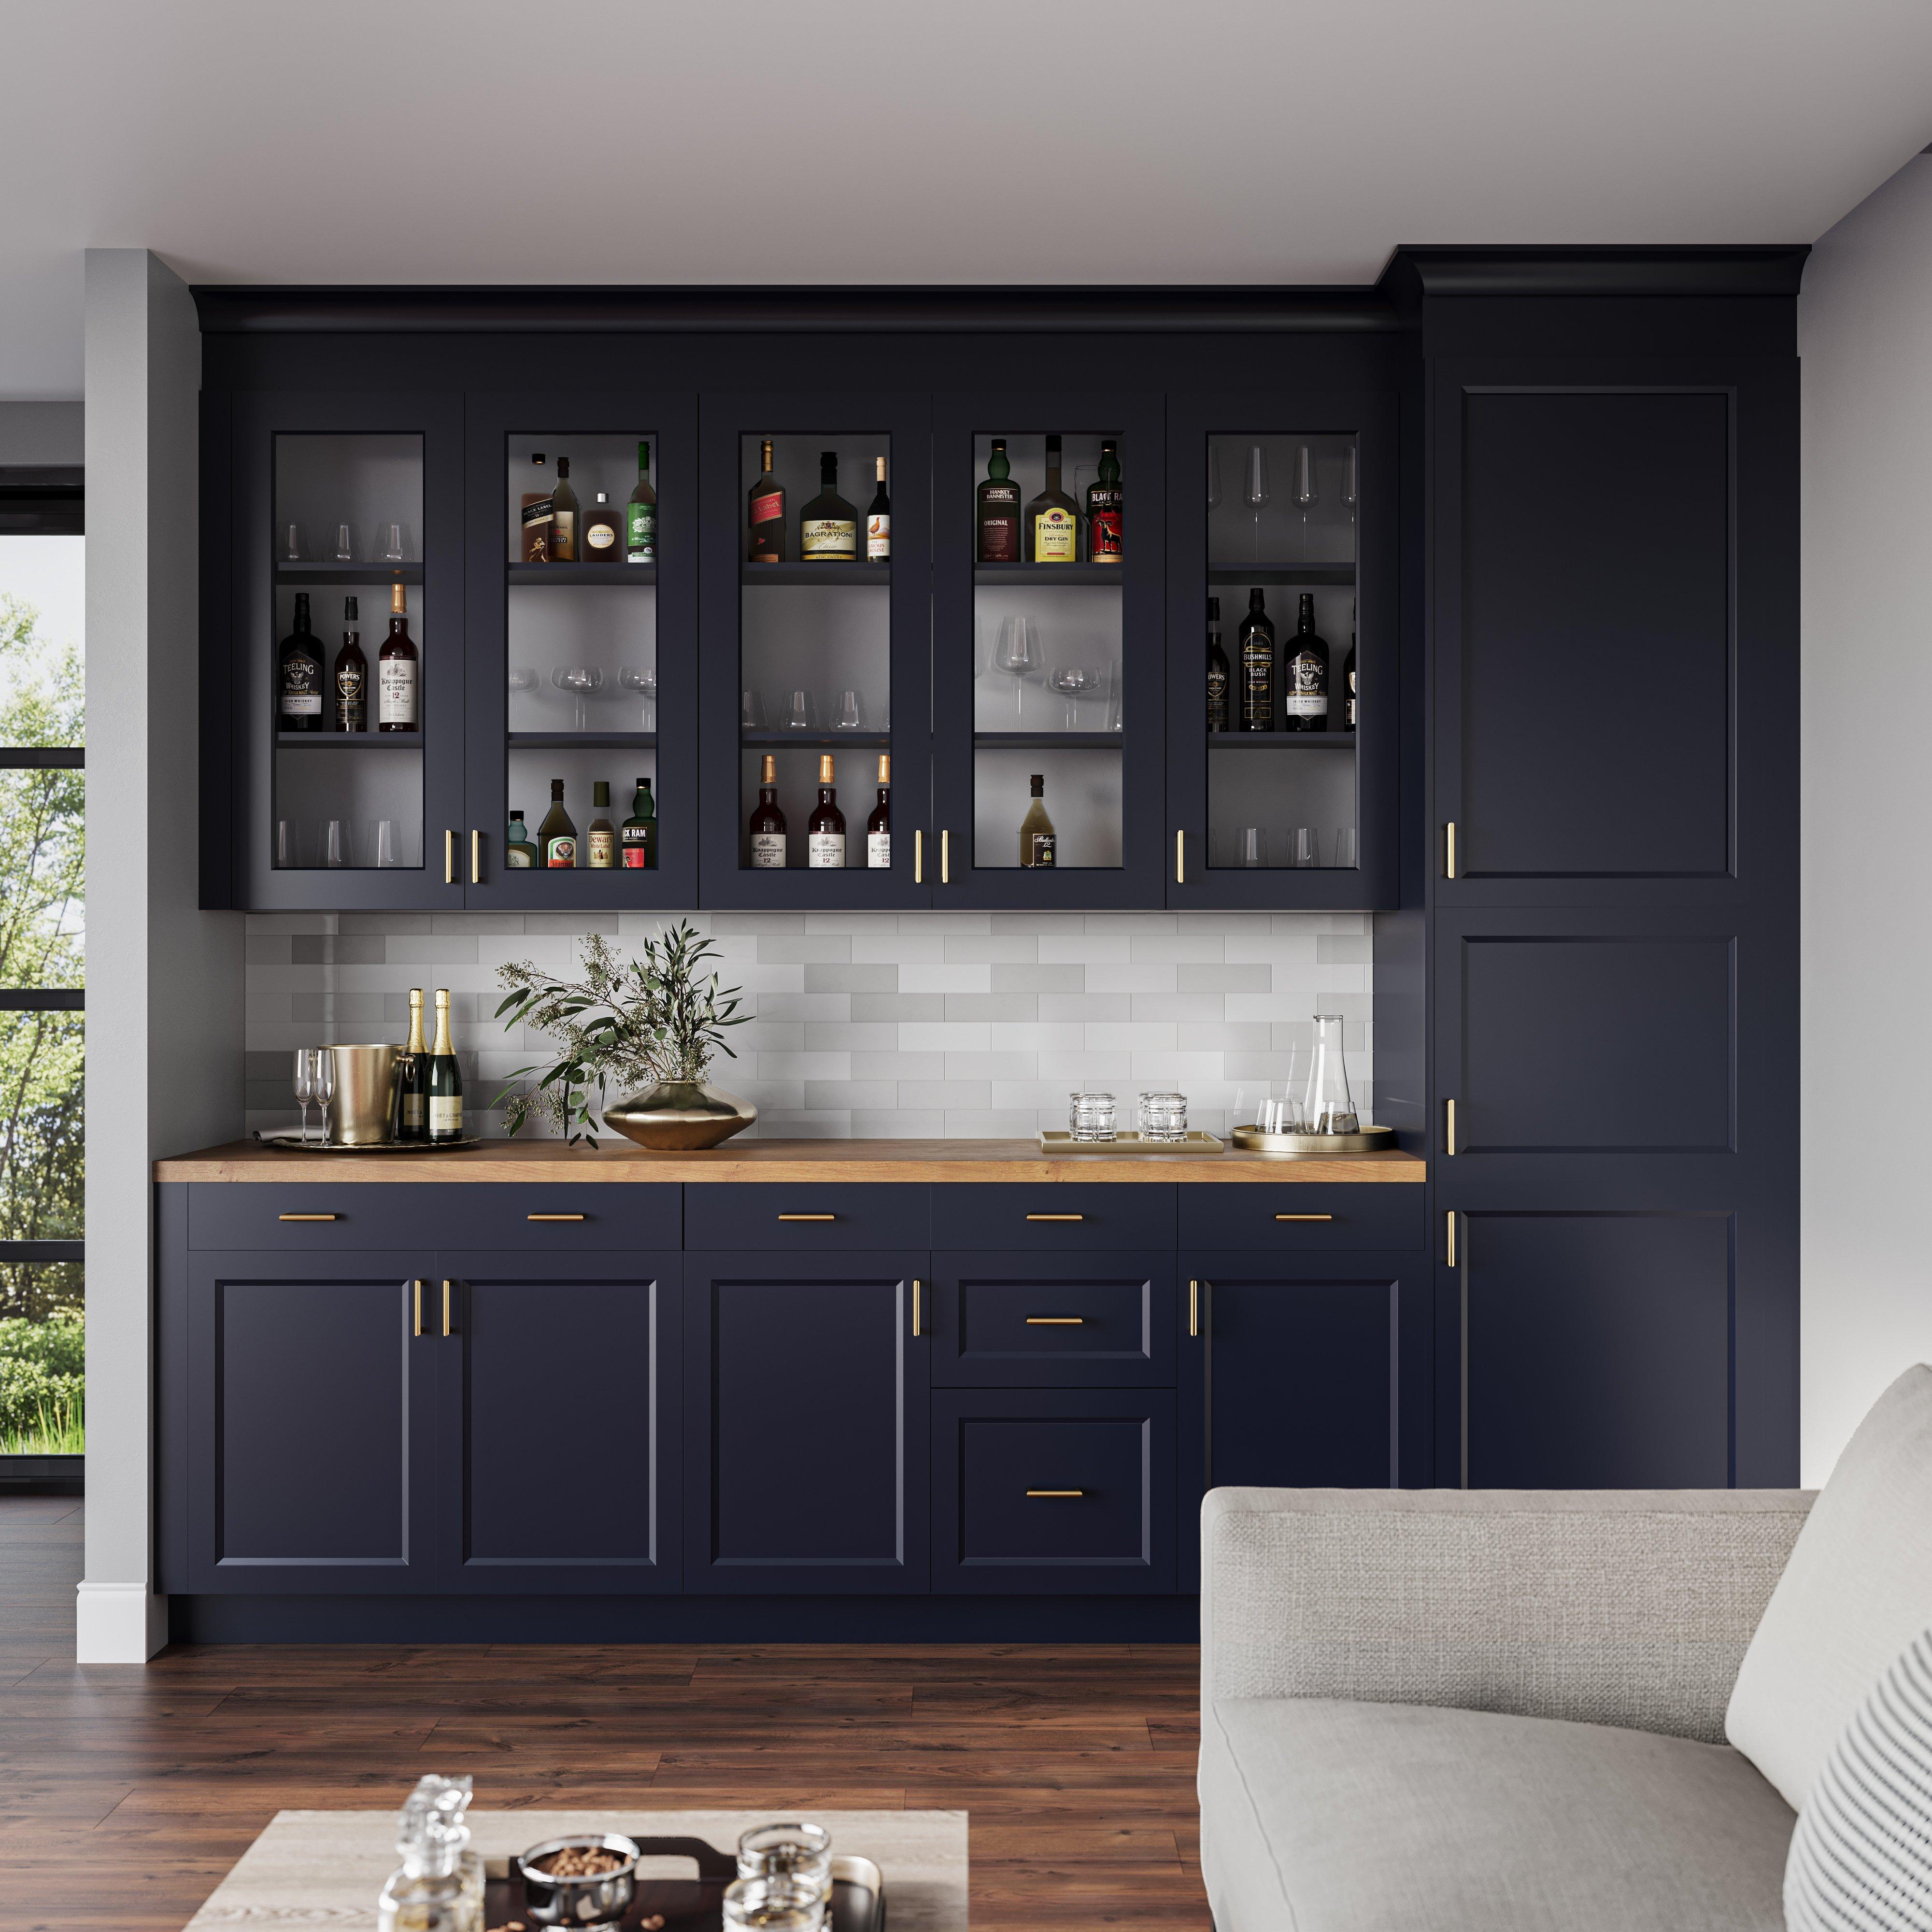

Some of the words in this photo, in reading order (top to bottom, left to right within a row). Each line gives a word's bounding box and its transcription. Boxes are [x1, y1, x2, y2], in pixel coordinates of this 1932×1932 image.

[1114, 493, 1122, 501] RA
[283, 663, 314, 674] TEELING
[1292, 663, 1322, 675] TEELING
[285, 682, 309, 690] WHISKEY
[1295, 682, 1319, 691] WHISKEY
[632, 829, 645, 837] RAM
